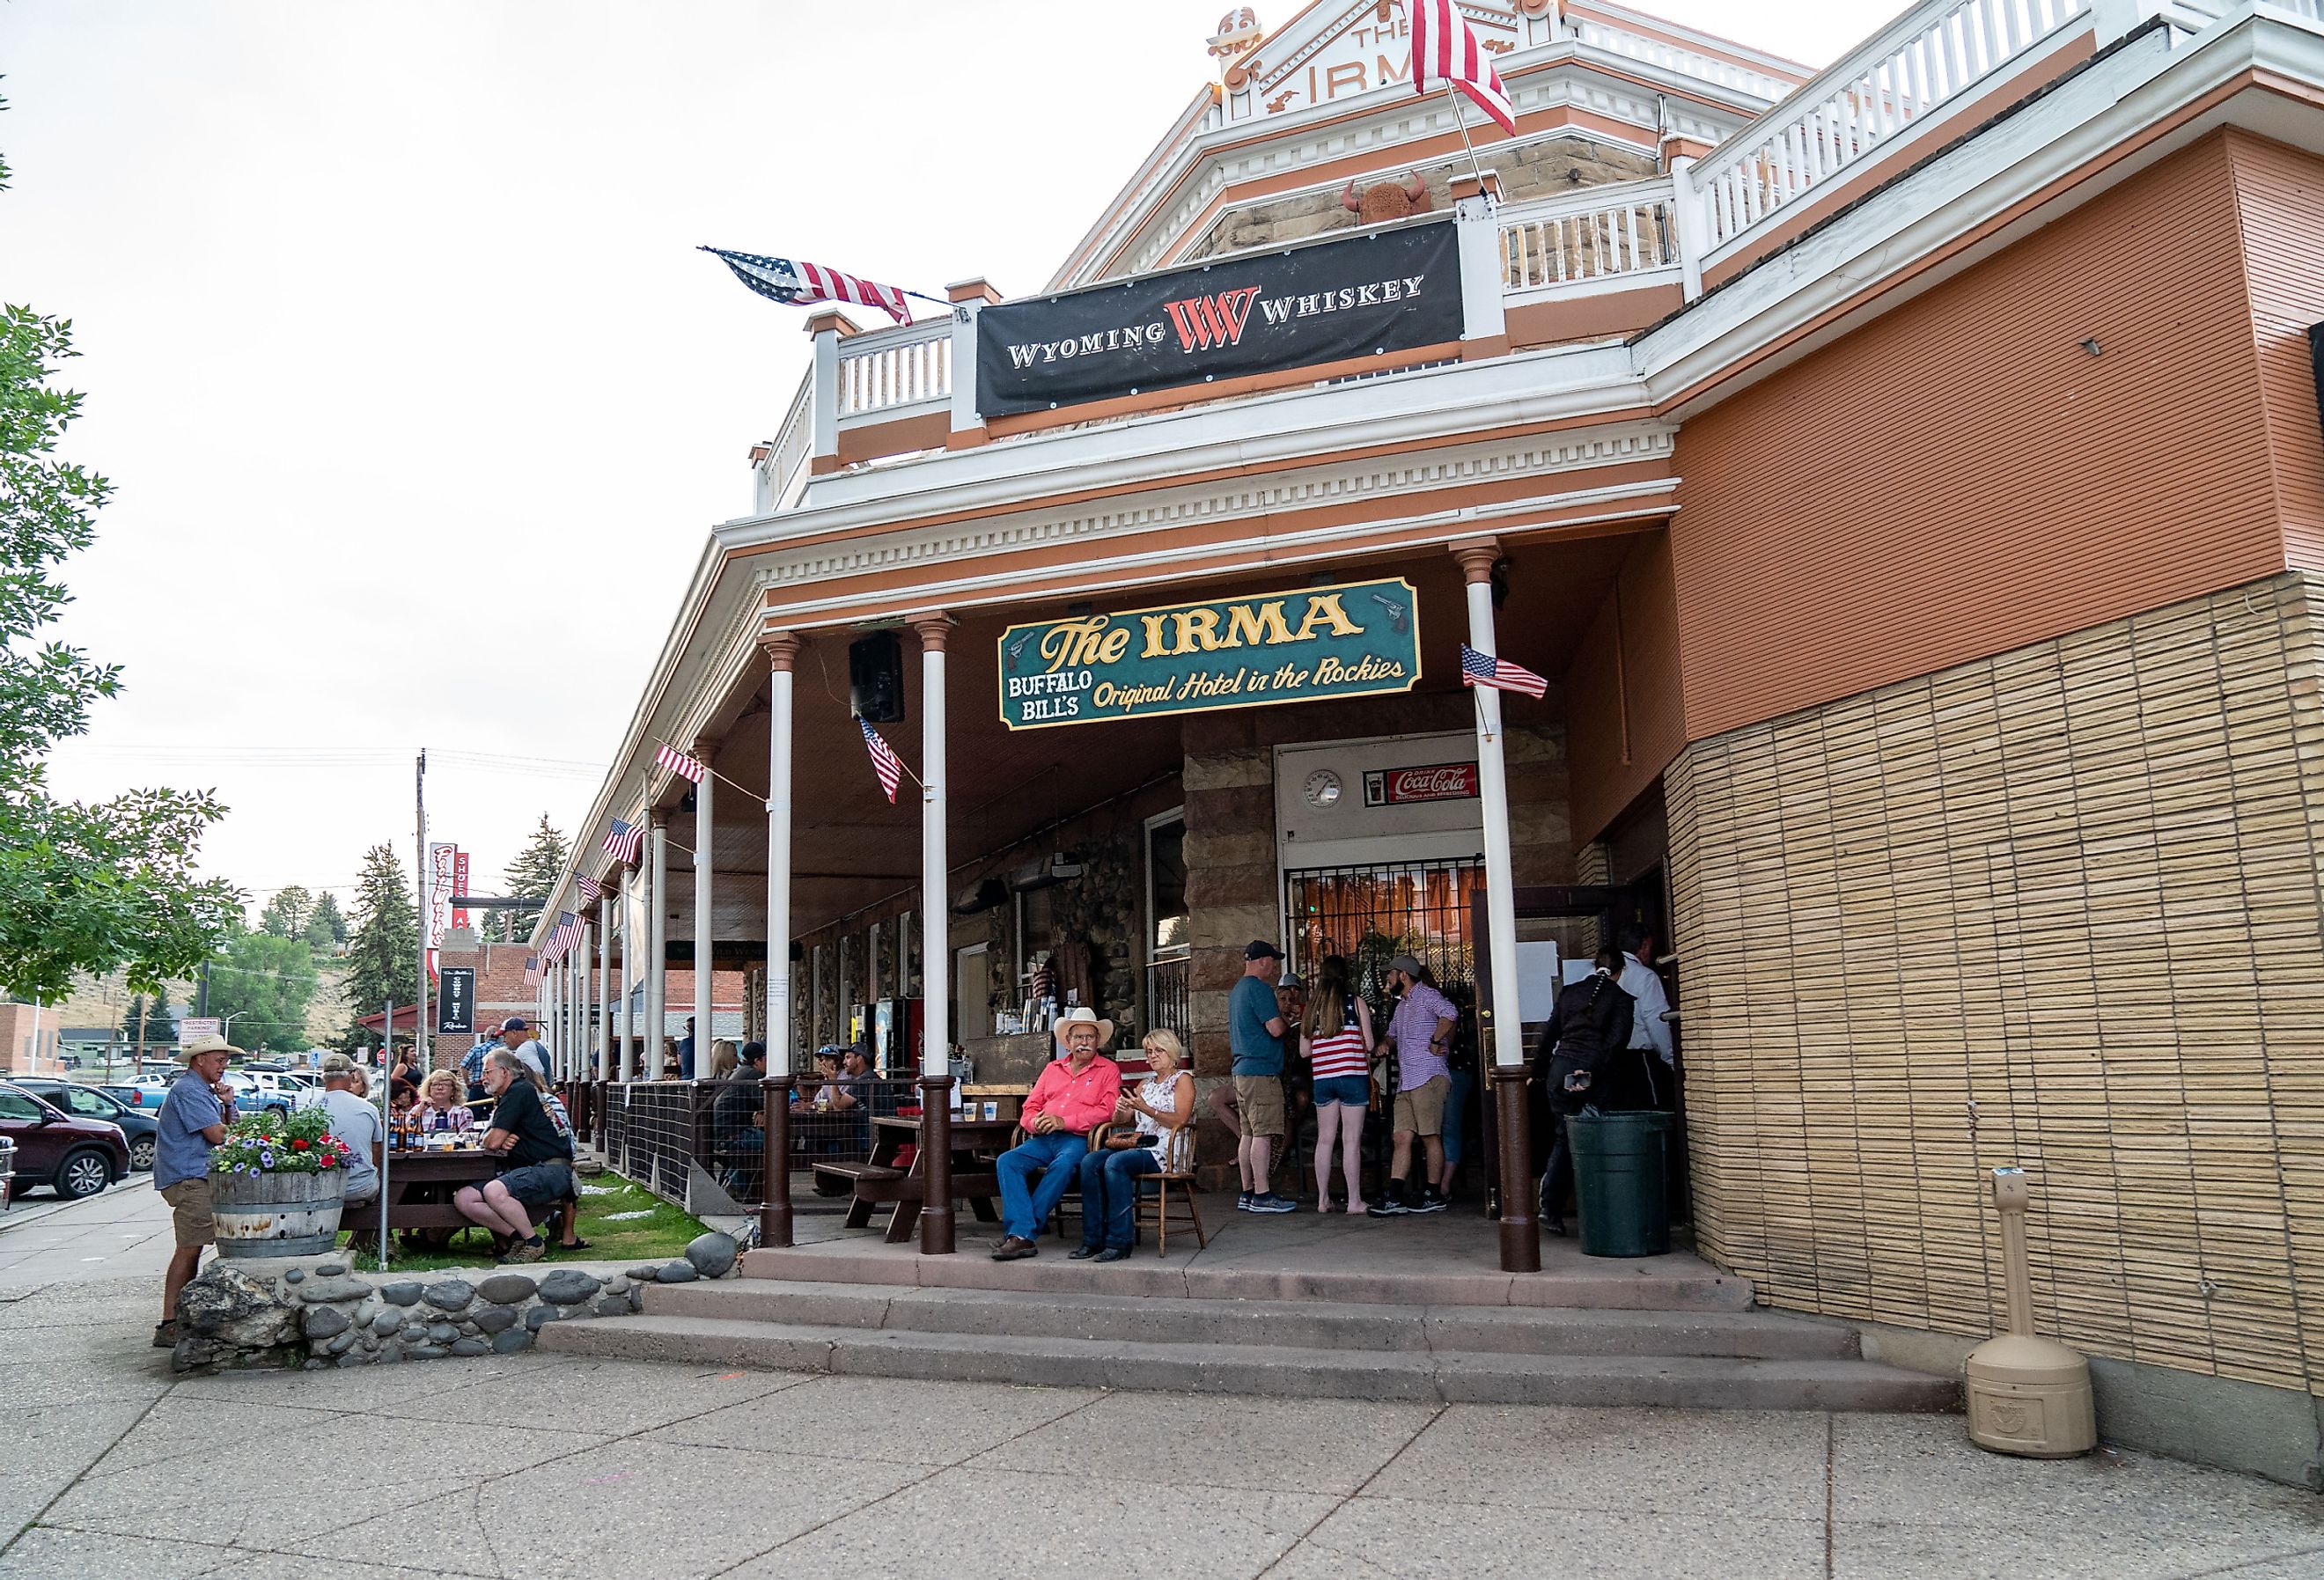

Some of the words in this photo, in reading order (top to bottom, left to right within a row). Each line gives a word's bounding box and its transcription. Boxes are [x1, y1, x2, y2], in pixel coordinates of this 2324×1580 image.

[1309, 48, 1411, 104] IRM
[1007, 320, 1166, 369] WYOMING
[1260, 275, 1424, 324] WHISKEY
[1040, 615, 1130, 673] The
[1140, 593, 1365, 659] IRMA
[1008, 670, 1092, 698] BUFFALO
[1021, 694, 1079, 721] BILL'S
[1092, 675, 1177, 713] Original
[1177, 666, 1243, 701] Hotel
[1250, 668, 1270, 691] in
[1272, 663, 1307, 689] the
[1311, 654, 1407, 687] Rockies
